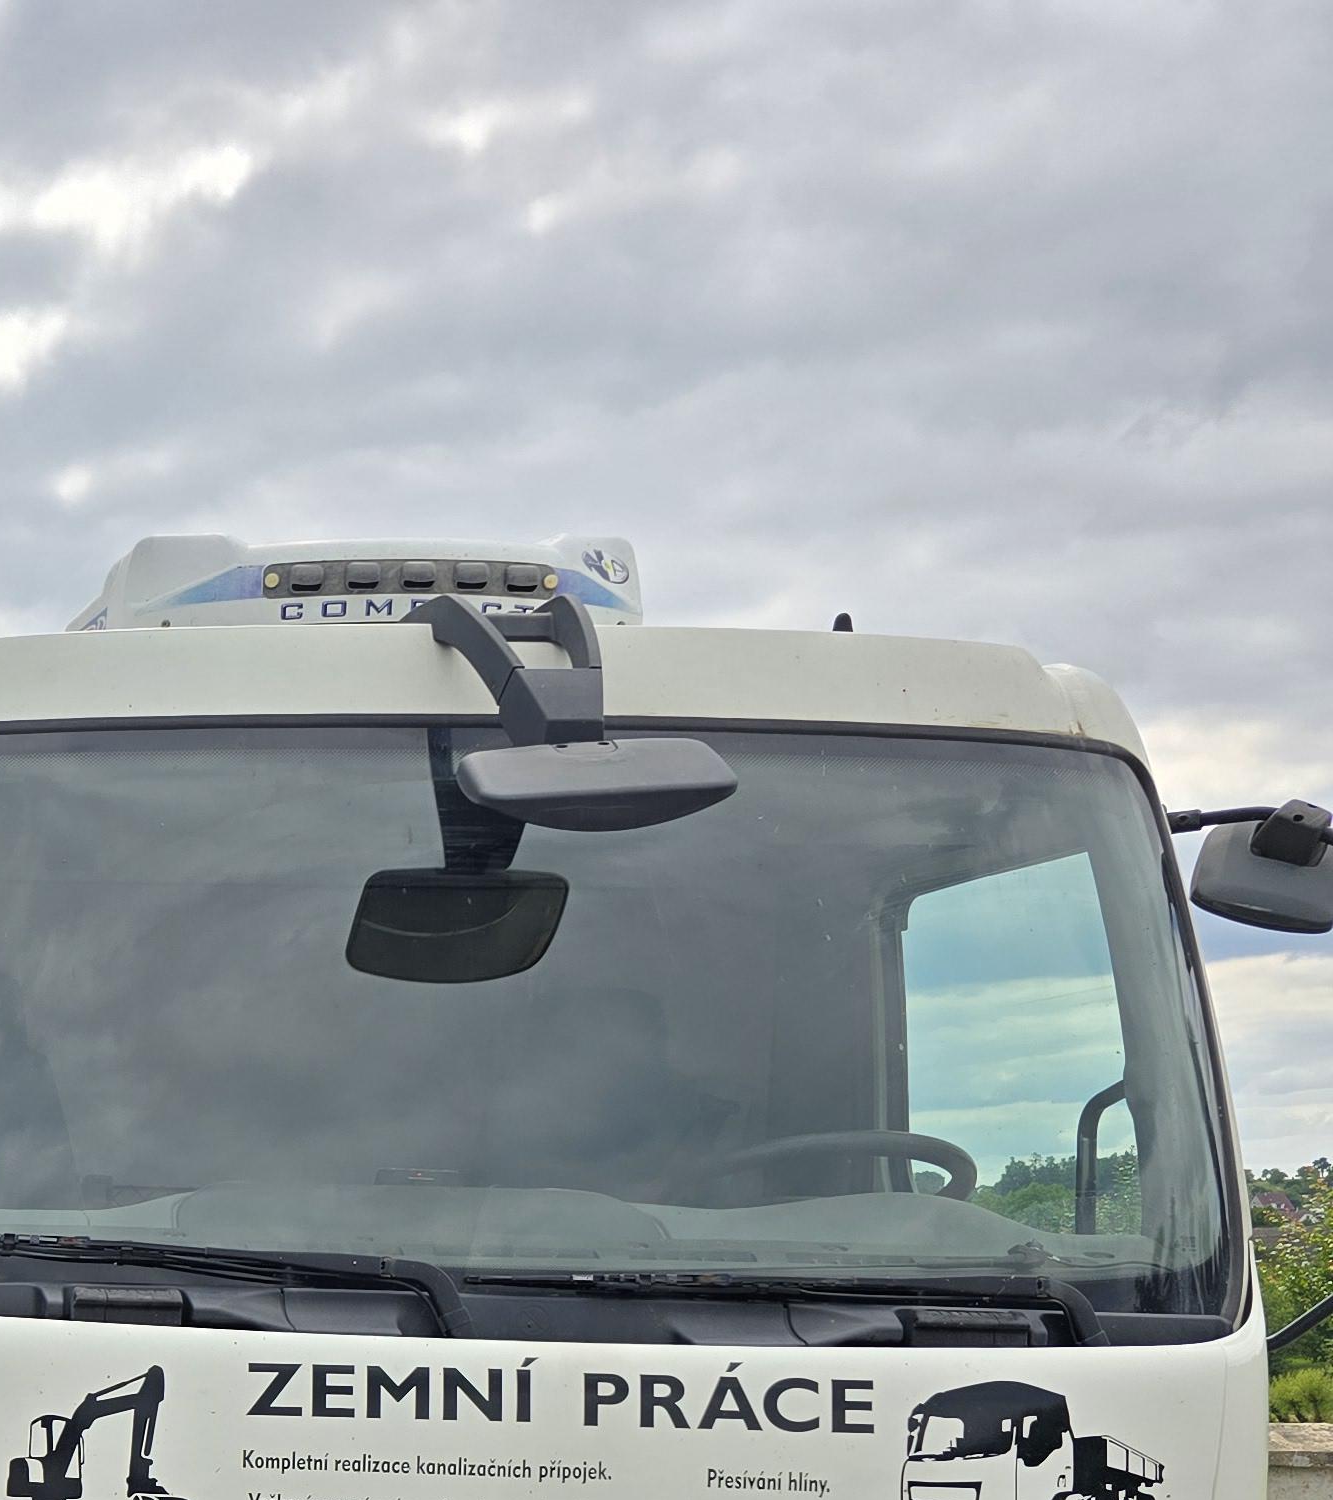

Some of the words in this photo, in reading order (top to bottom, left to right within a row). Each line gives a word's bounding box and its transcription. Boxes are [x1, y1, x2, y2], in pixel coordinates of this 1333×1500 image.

[246, 1357, 539, 1423] ZEMNÍ
[583, 1362, 875, 1434] PRÁCE
[242, 1449, 329, 1475] Kompletní
[334, 1453, 411, 1474] realizace
[416, 1455, 532, 1479] kanalizačních
[538, 1459, 612, 1485] přípojek.
[706, 1468, 783, 1491] Přesívání
[788, 1471, 831, 1498] hlíny.
